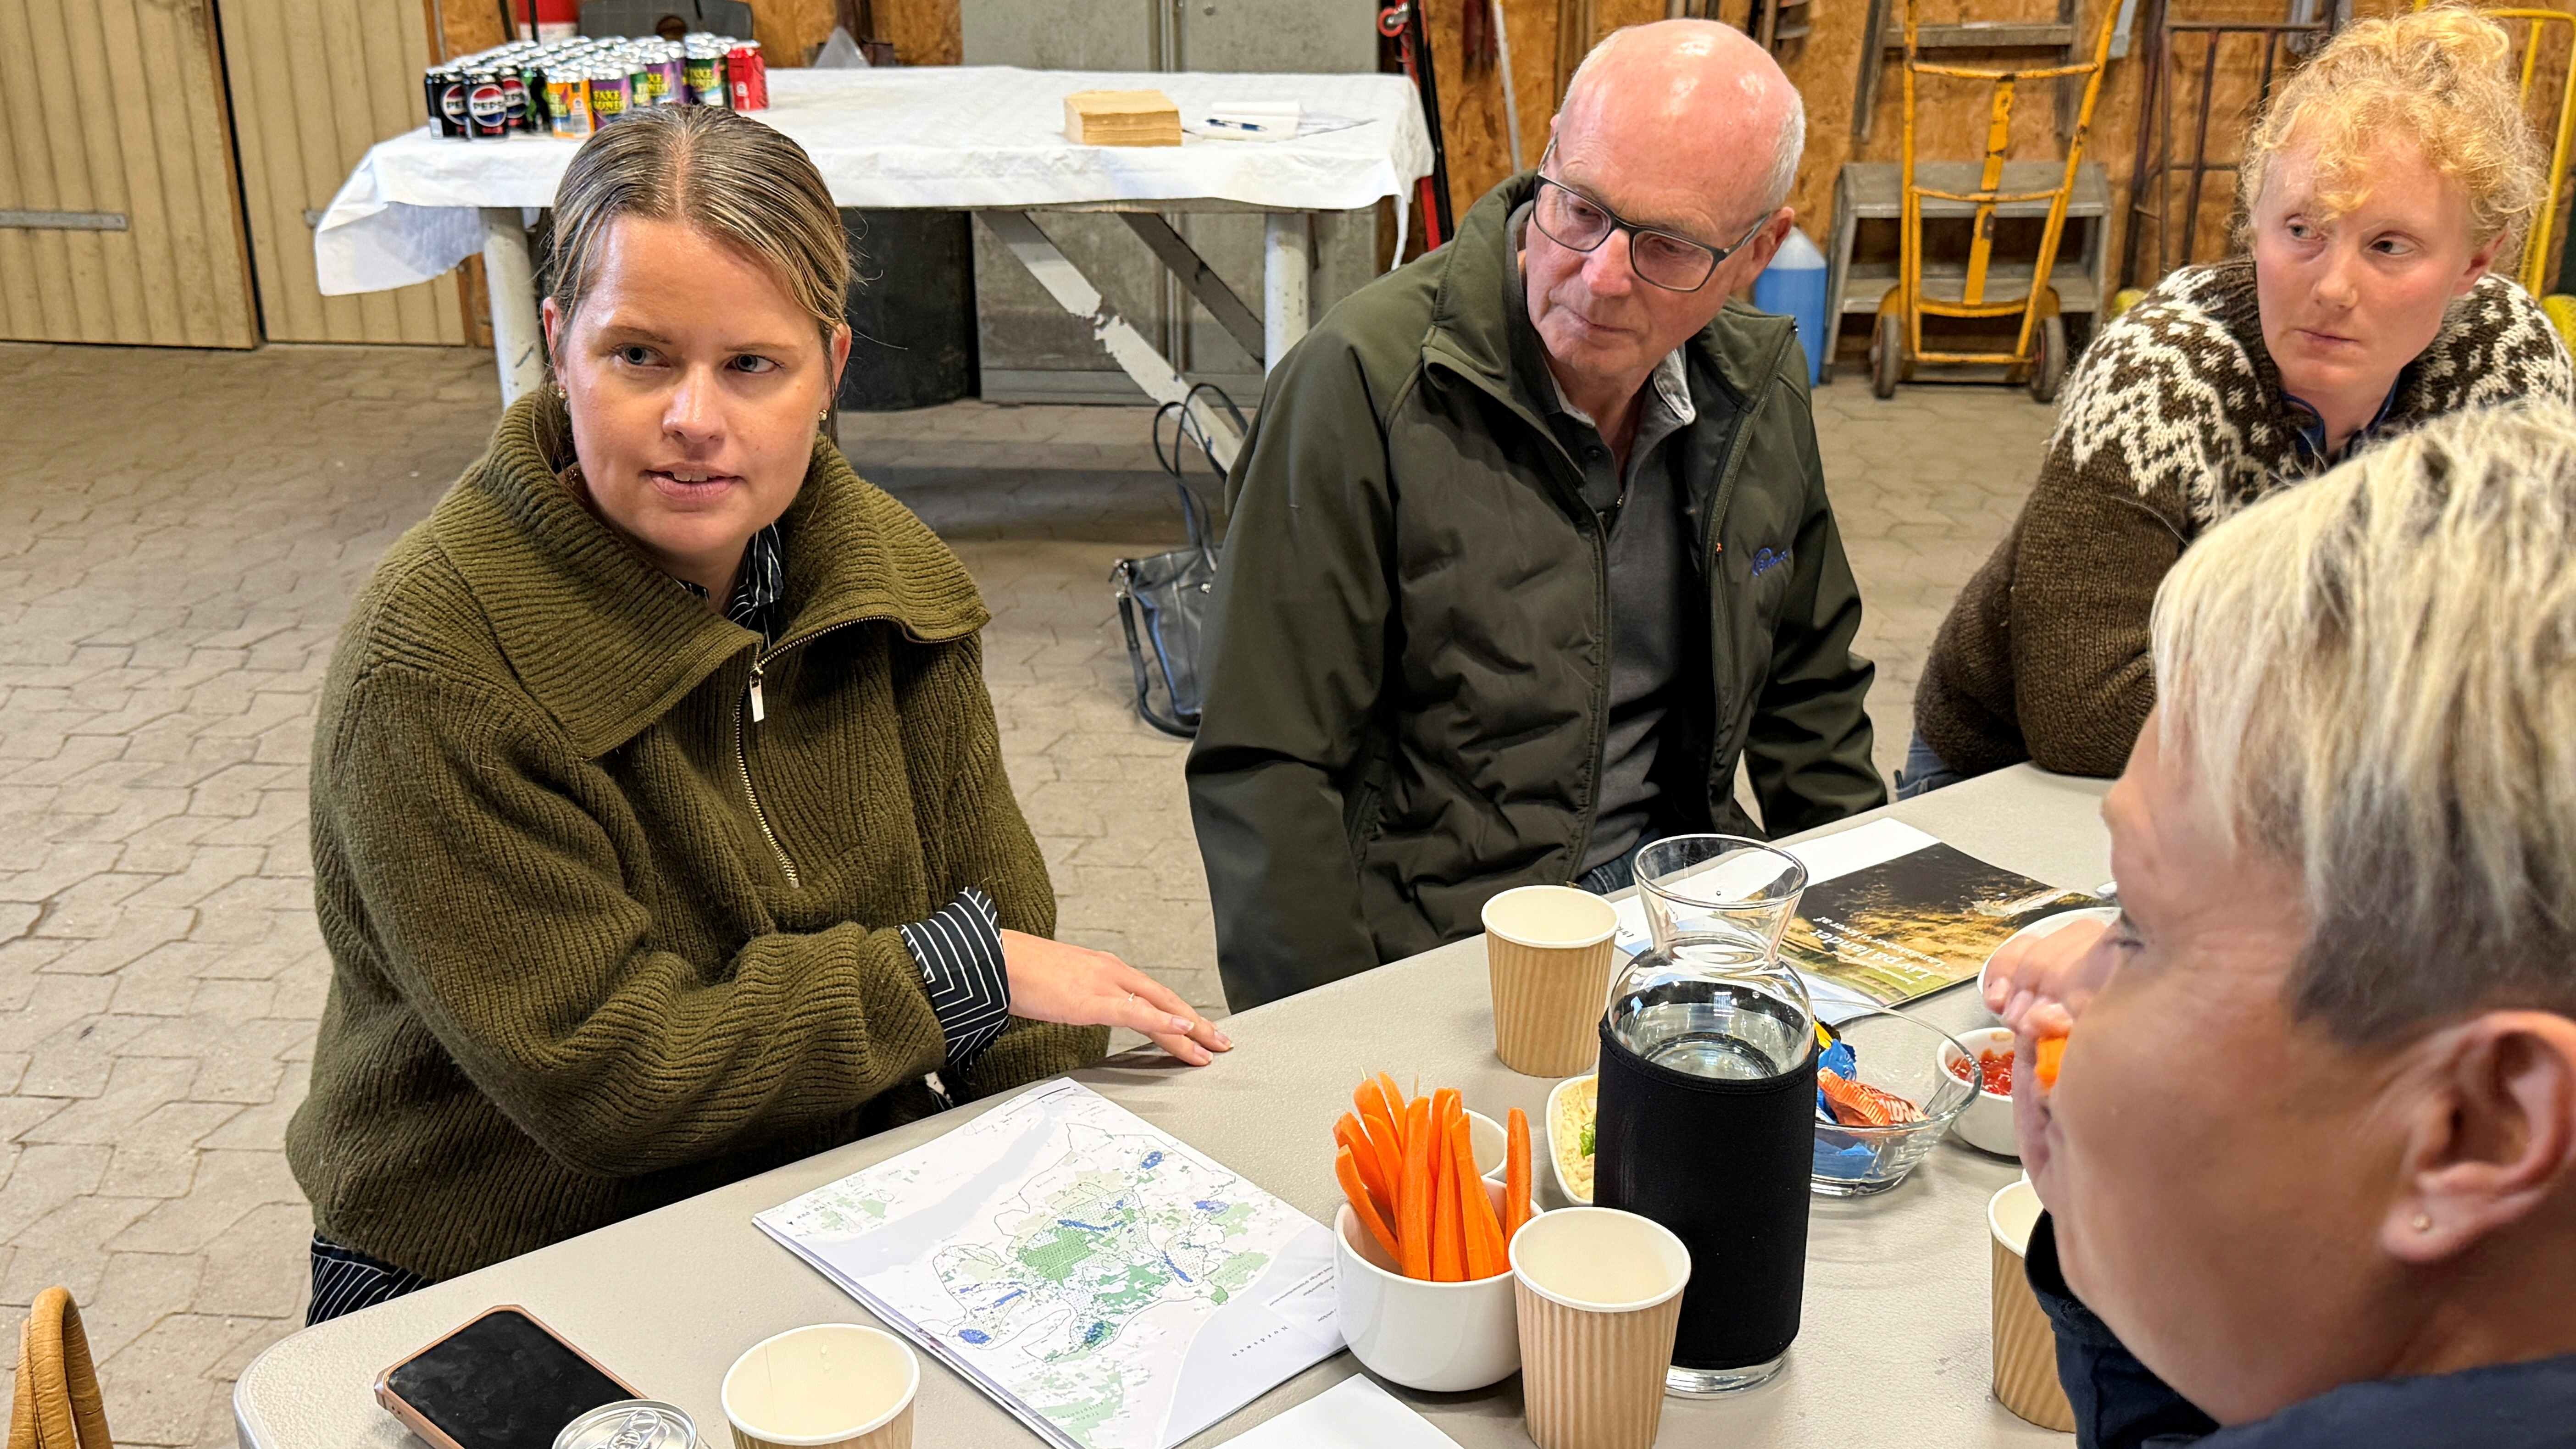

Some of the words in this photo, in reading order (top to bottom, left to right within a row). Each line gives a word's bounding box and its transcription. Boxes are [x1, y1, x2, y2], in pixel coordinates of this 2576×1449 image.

[1810, 929, 1876, 957] landet
[1869, 951, 1905, 964] på
[1897, 963, 1931, 980] Liv
